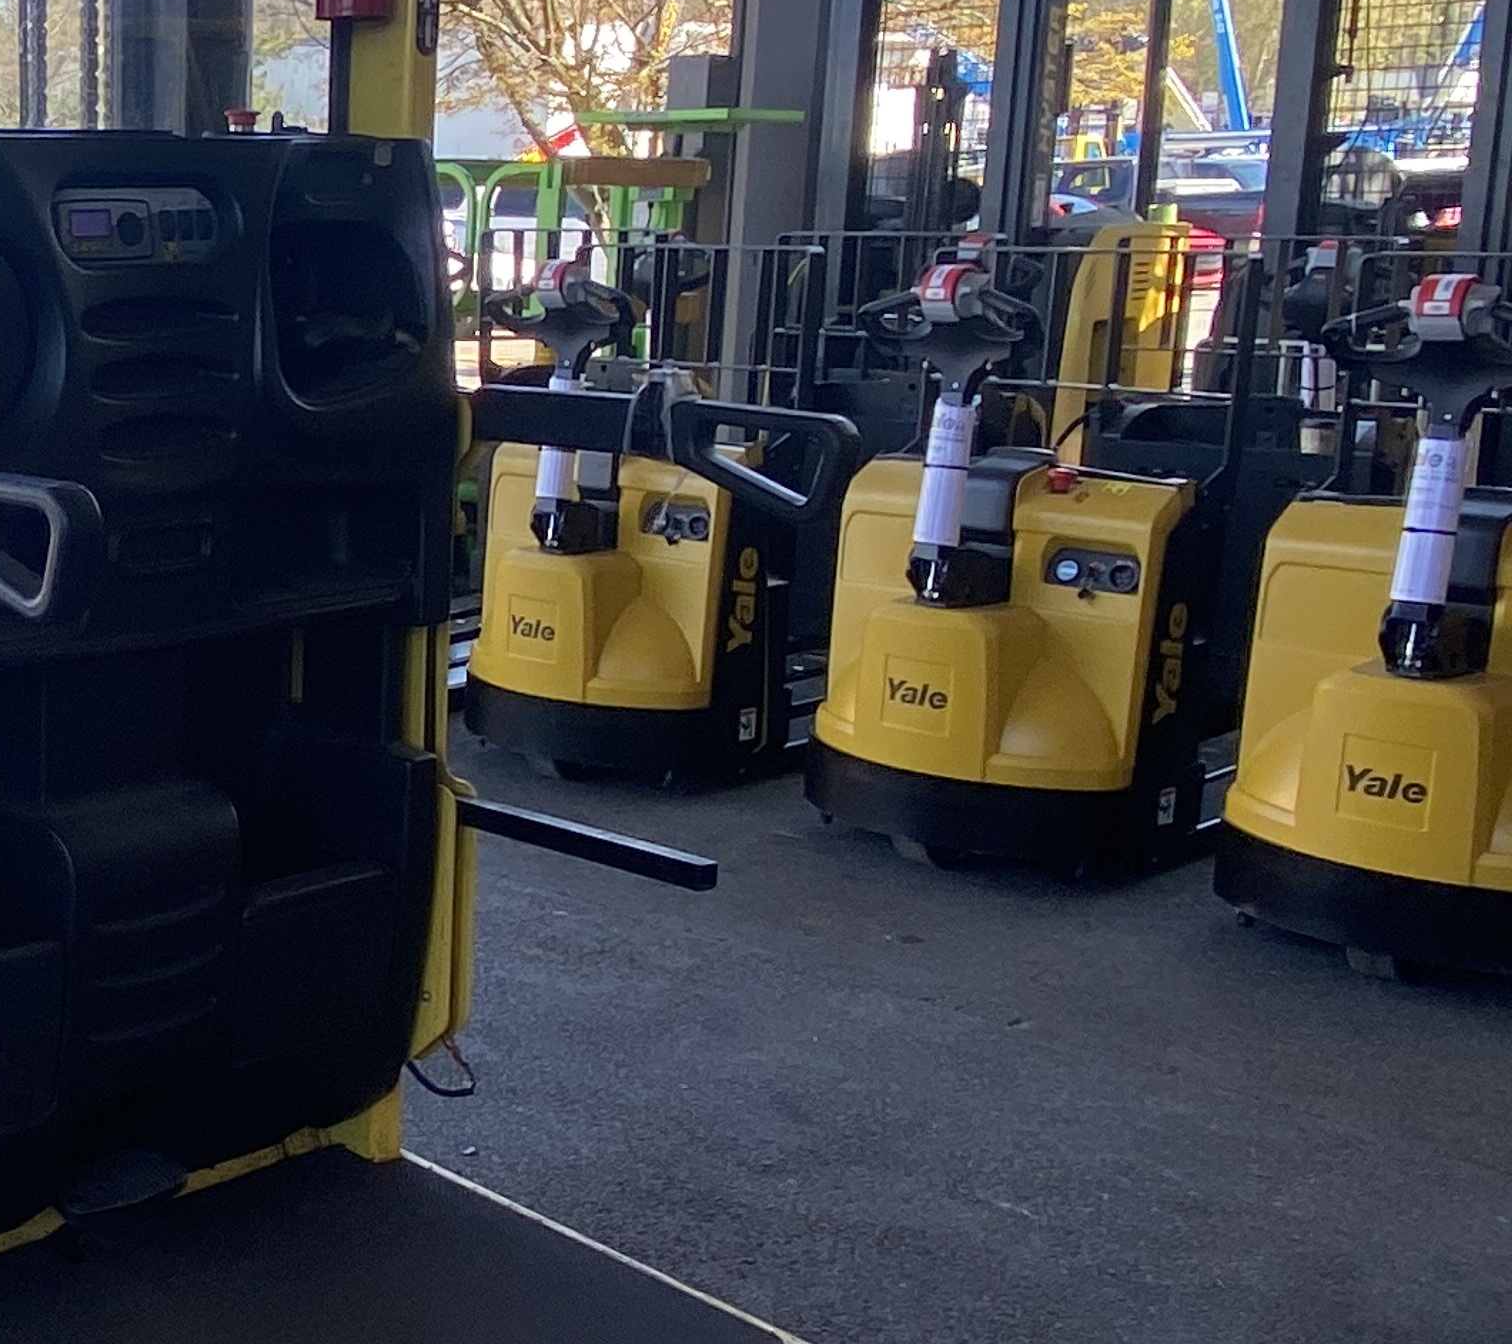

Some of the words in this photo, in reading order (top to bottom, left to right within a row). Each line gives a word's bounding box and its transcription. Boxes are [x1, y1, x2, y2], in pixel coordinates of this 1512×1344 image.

[726, 547, 759, 652] Yale
[511, 614, 555, 641] Yale
[1151, 602, 1188, 725] Yale
[888, 677, 948, 710] Yale
[1346, 764, 1427, 803] Yale
